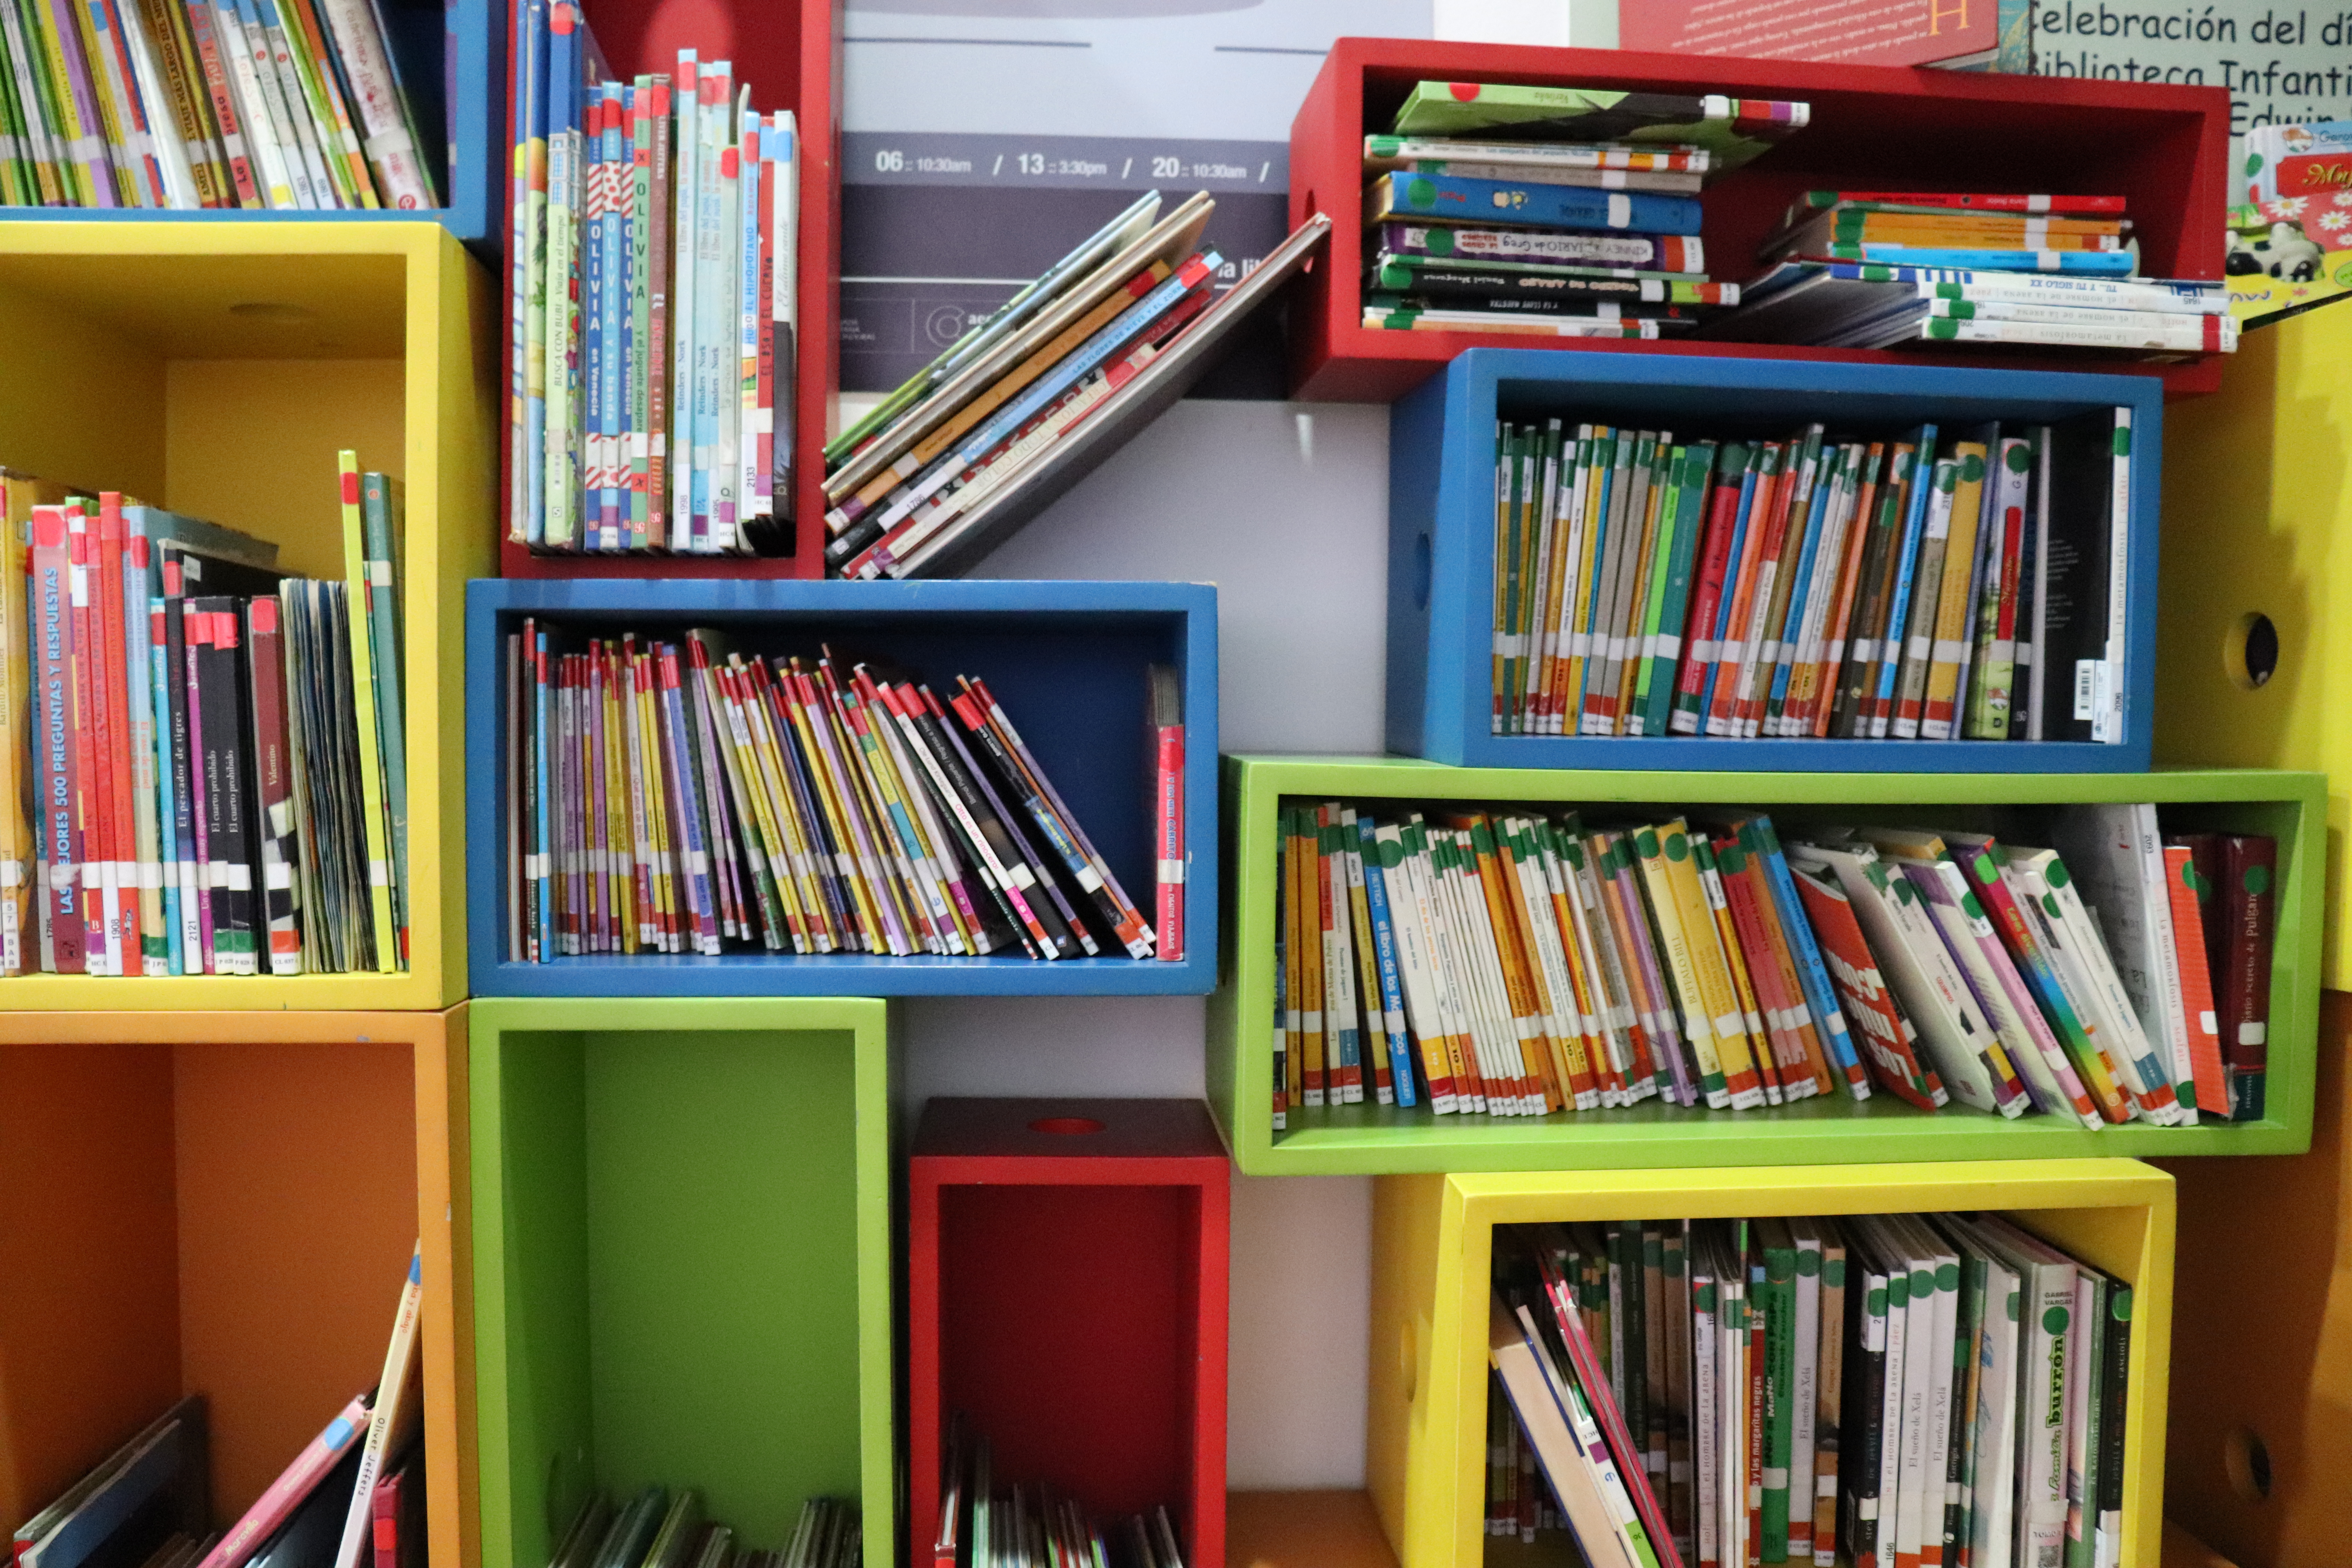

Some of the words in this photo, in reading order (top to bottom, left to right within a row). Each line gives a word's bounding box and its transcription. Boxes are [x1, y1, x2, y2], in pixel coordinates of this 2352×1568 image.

[156, 19, 170, 40] DEL
[2034, 0, 2236, 42] elebración
[2251, 9, 2305, 45] del
[162, 42, 180, 79] LARGO
[2034, 51, 2203, 85] iblioteca
[655, 142, 666, 179] JEFFERS
[875, 151, 903, 172] 06
[917, 157, 971, 172] 10:30am
[1019, 153, 1044, 174] 13
[1059, 160, 1107, 178] 3:30pm
[1151, 156, 1180, 178] 20
[1192, 164, 1247, 179] 10:30am
[234, 165, 248, 184] La
[678, 210, 687, 221] del
[555, 215, 566, 246] tiempo
[636, 183, 645, 298] OLIVIA
[678, 224, 687, 243] libro
[1502, 234, 1531, 251] Greg
[557, 260, 563, 269] en
[607, 217, 616, 324] OLIVIA
[590, 225, 600, 330] OLIVIA
[2030, 279, 2042, 287] XX
[2046, 280, 2073, 290] SIGLO
[2076, 282, 2086, 290] TU
[652, 293, 664, 309] EL
[761, 305, 772, 318] EL
[554, 304, 563, 327] BUBI
[554, 331, 563, 351] CON
[742, 316, 756, 344] HUGO
[637, 339, 644, 347] el
[677, 340, 686, 363] Nork
[1086, 338, 1116, 362] FLORES
[1114, 330, 1125, 340] DE
[591, 348, 599, 363] en
[606, 354, 614, 369] su
[698, 345, 706, 367] Nork
[553, 356, 563, 385] BUSCA
[635, 350, 644, 386] juguete
[761, 363, 772, 376] EL
[591, 367, 599, 416] Venecia
[606, 376, 615, 420] banda
[677, 372, 686, 411] Reinders
[698, 376, 706, 414] Reinders
[711, 378, 719, 416] Reinders
[1011, 429, 1045, 458] TODO
[746, 466, 755, 487] 2133
[972, 454, 1014, 489] COLOR
[906, 494, 926, 511] 1786
[43, 567, 62, 659] RESPUESTAS
[48, 664, 62, 674] Y
[2114, 693, 2122, 711] 2096
[48, 680, 67, 771] PREGUNTAS
[172, 711, 184, 742] tigres
[174, 747, 183, 759] de
[267, 744, 278, 785] Valentino
[924, 756, 937, 771] Lund
[207, 750, 220, 792] prohibido
[226, 750, 238, 792] prohibido
[53, 777, 69, 806] 500
[175, 764, 188, 811] pescador
[196, 800, 208, 836] esperado
[211, 794, 220, 820] cuarto
[229, 794, 237, 821] cuarto
[178, 817, 187, 827] El
[211, 823, 220, 832] El
[229, 823, 238, 832] El
[953, 802, 969, 821] Otto
[964, 820, 973, 829] es
[970, 829, 980, 839] un
[55, 812, 71, 866] EJORES
[199, 838, 208, 855] muy
[1166, 820, 1176, 859] CABRITO
[2143, 834, 2155, 854] 2093
[59, 886, 74, 914] LAS
[1370, 873, 1383, 906] RETTICH
[200, 896, 209, 909] Un
[111, 919, 122, 939] 1908
[188, 921, 198, 940] 2121
[1377, 921, 1387, 930] el
[1378, 932, 1392, 957] libro
[1670, 933, 1684, 956] BILL
[2246, 942, 2255, 952] de
[1383, 959, 1395, 974] de
[2244, 956, 2255, 992] secreto
[1386, 975, 1398, 992] los
[1677, 958, 1697, 1004] BUFFALO
[397, 1308, 415, 1334] abajo
[1800, 1367, 1811, 1386] Xelá
[2047, 1337, 2064, 1425] burrón
[1750, 1375, 1763, 1405] negras
[1800, 1390, 1810, 1399] de
[1934, 1386, 1946, 1406] Xelá
[1800, 1402, 1810, 1426] sueño
[1910, 1392, 1922, 1413] Xelá
[1910, 1416, 1920, 1426] de
[1935, 1410, 1944, 1420] de
[369, 1417, 385, 1451] Oliver
[1749, 1407, 1763, 1455] margaritas
[1799, 1430, 1809, 1439] El
[1909, 1429, 1920, 1455] sueño
[1933, 1422, 1944, 1448] sueño
[1750, 1457, 1760, 1470] las
[1909, 1457, 1918, 1467] El
[1933, 1451, 1942, 1461] El
[357, 1454, 376, 1497] Jeffers
[1886, 1543, 1894, 1560] 1646
